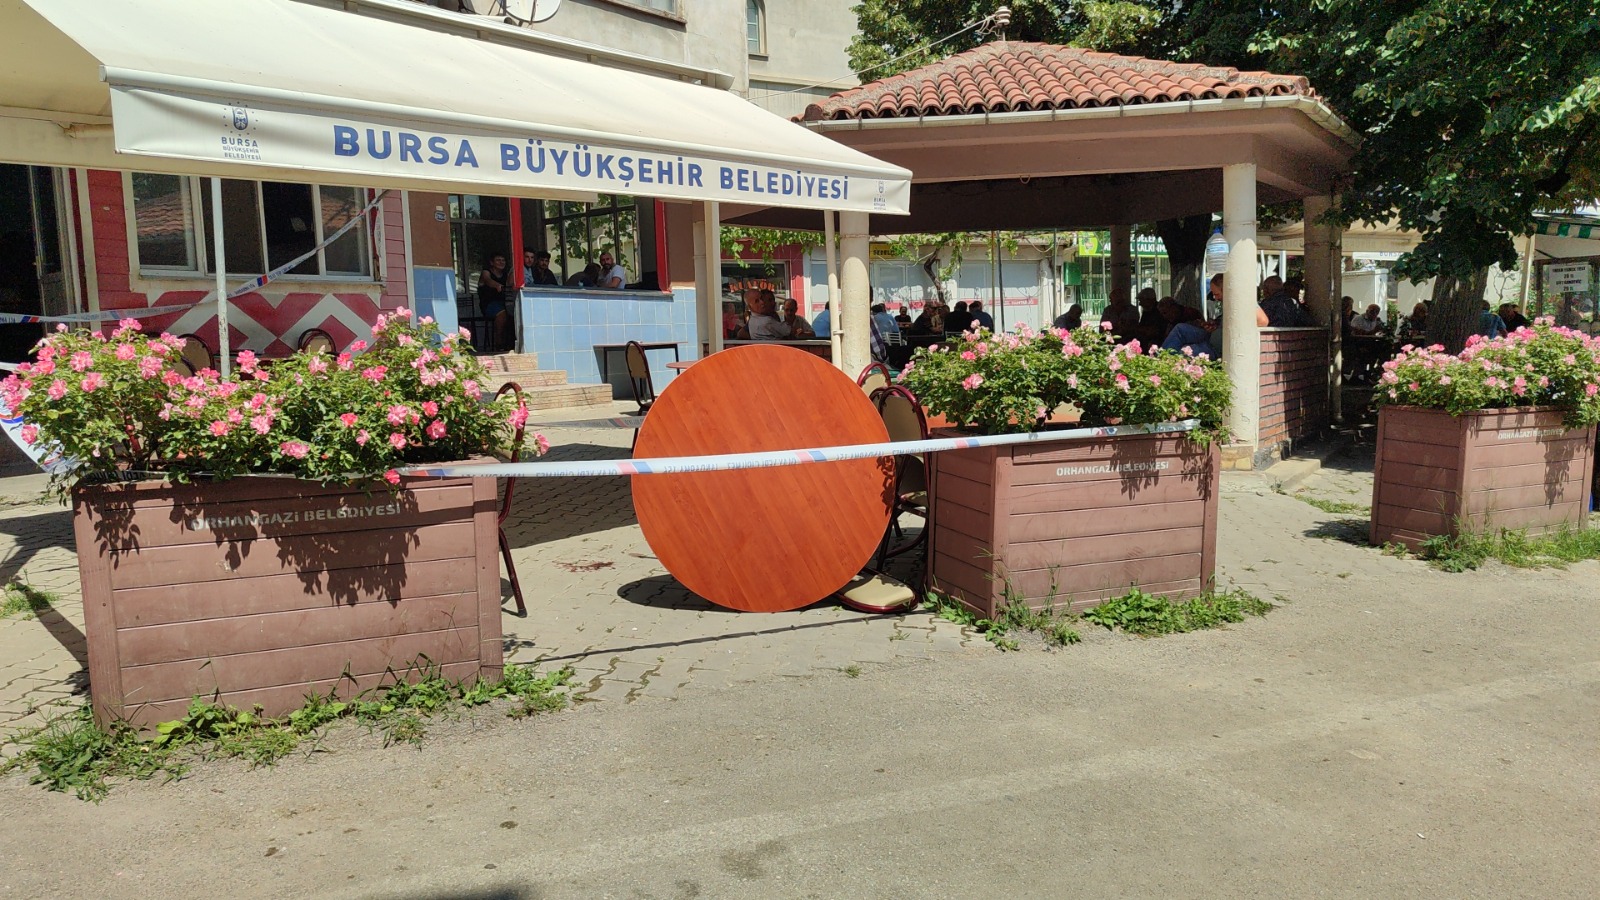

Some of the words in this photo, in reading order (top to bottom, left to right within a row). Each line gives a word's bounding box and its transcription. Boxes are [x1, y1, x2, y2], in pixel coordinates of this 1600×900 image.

[221, 136, 259, 148] BURSA
[333, 124, 479, 169] BURSA
[499, 138, 704, 188] BÜYÜKŞEHİR
[719, 166, 849, 201] BELEDİYESİ
[1056, 463, 1115, 477] ORHANGAZİ
[1115, 461, 1169, 473] BELEDİYESİ
[191, 511, 299, 531] ORHANGAZİ
[304, 503, 400, 522] BELEDİYESİ
